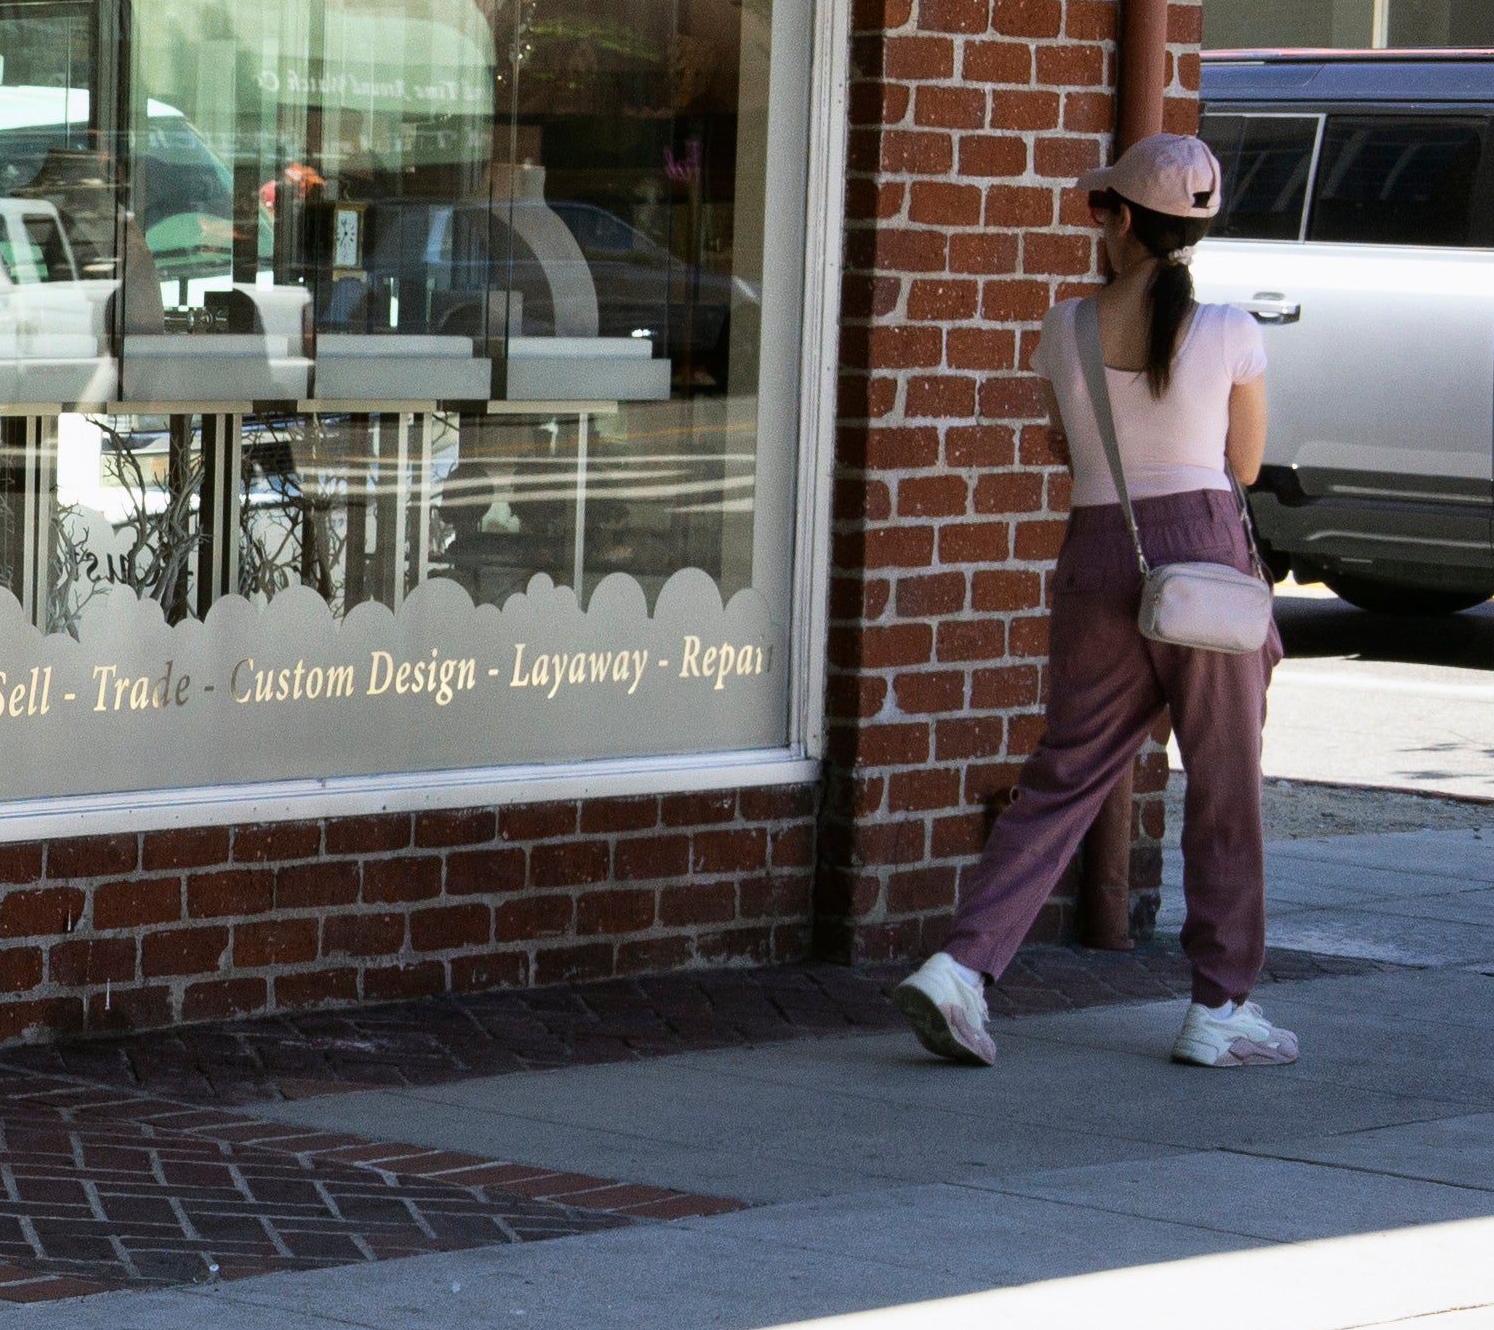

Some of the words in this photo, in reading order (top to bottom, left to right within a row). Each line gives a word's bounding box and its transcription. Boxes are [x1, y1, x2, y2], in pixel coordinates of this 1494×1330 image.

[92, 660, 191, 713] Trade
[230, 657, 355, 704] Custom
[366, 647, 476, 706] Design
[509, 642, 649, 700] Layaway
